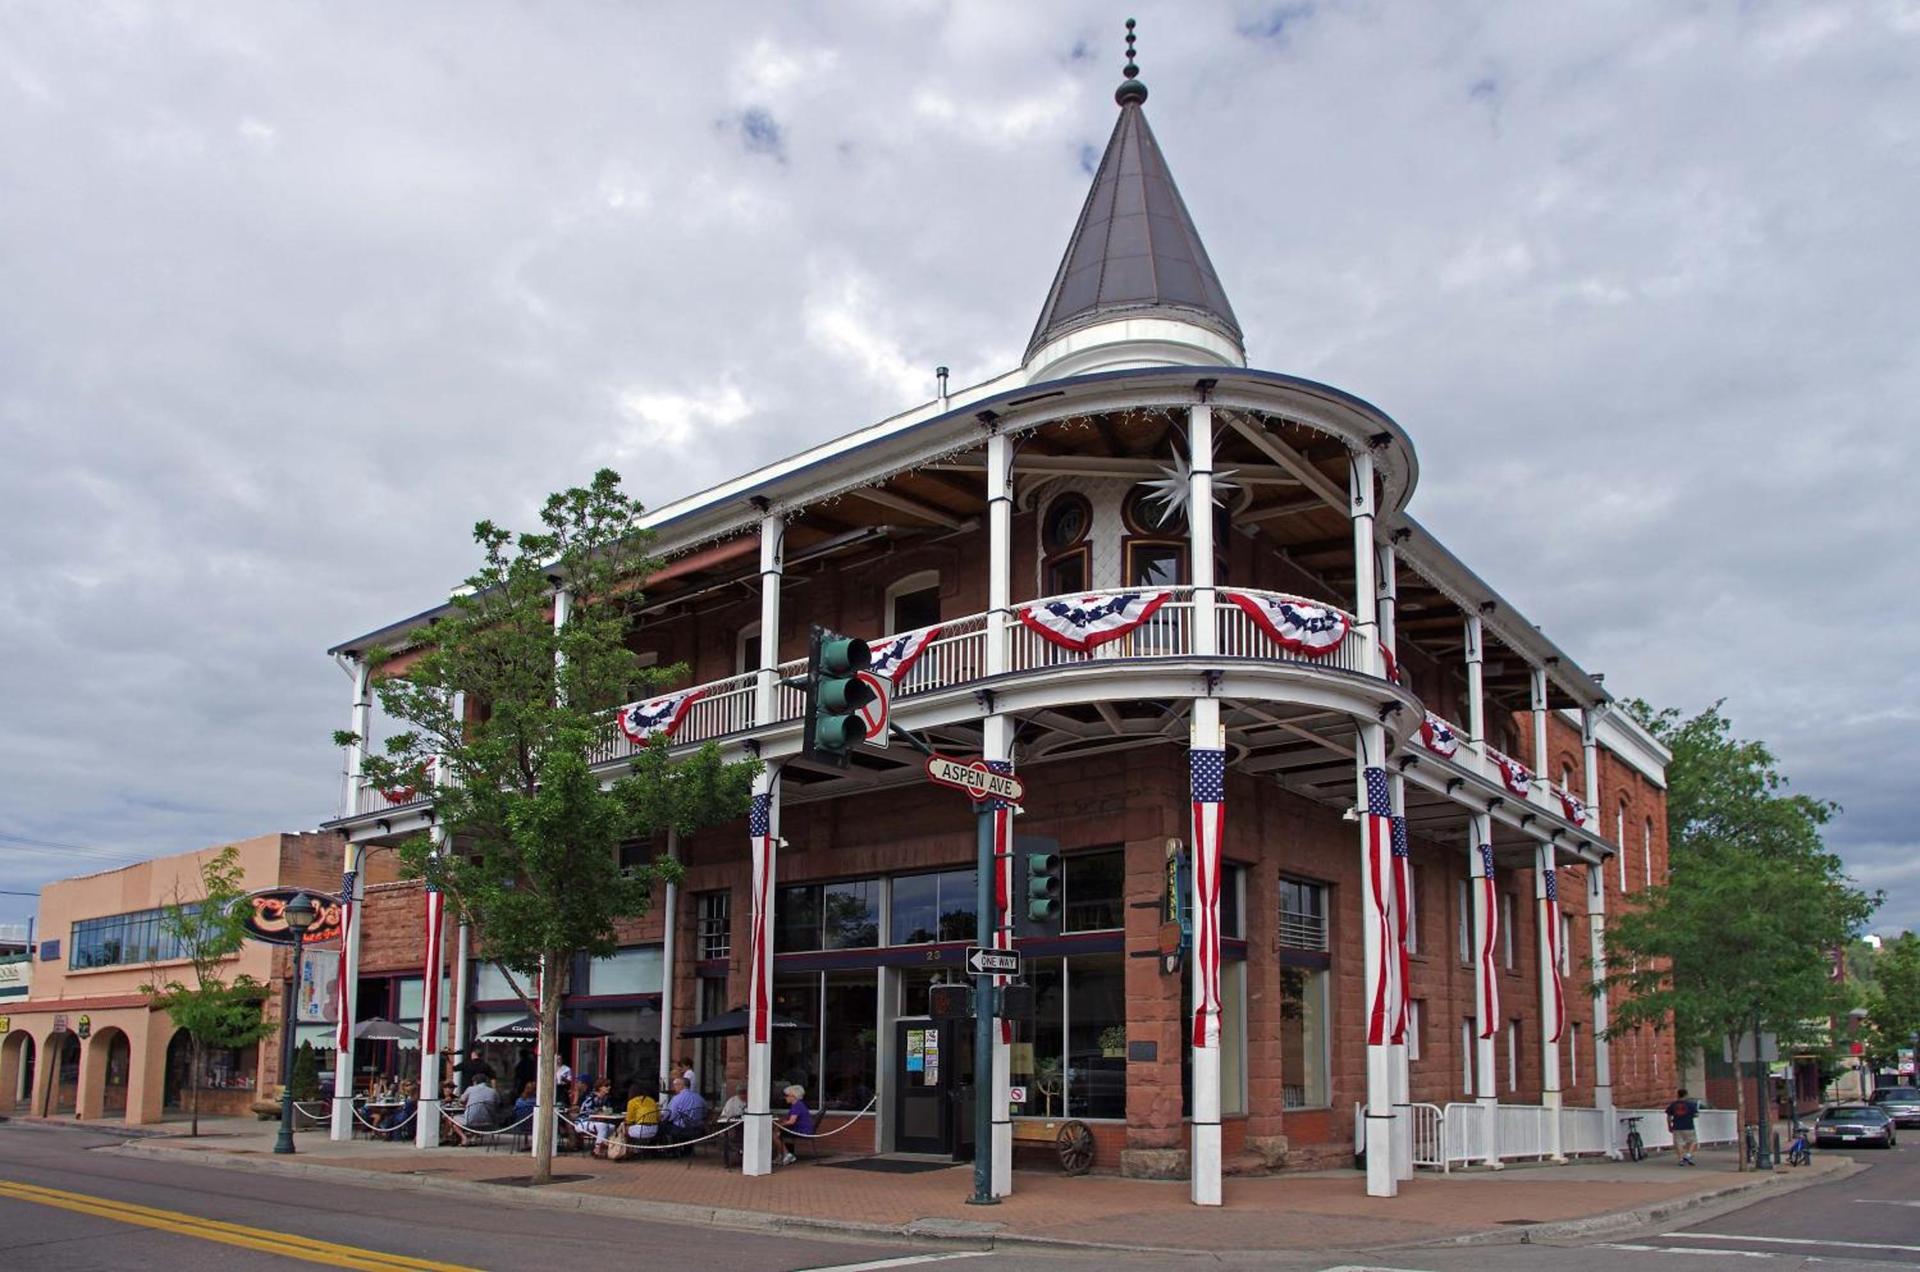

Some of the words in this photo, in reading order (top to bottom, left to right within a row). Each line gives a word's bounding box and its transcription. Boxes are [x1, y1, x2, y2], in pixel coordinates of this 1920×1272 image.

[942, 763, 984, 787] ASPEN
[989, 776, 1012, 795] AVE
[981, 955, 997, 967] ONE
[1000, 956, 1015, 968] WAY
